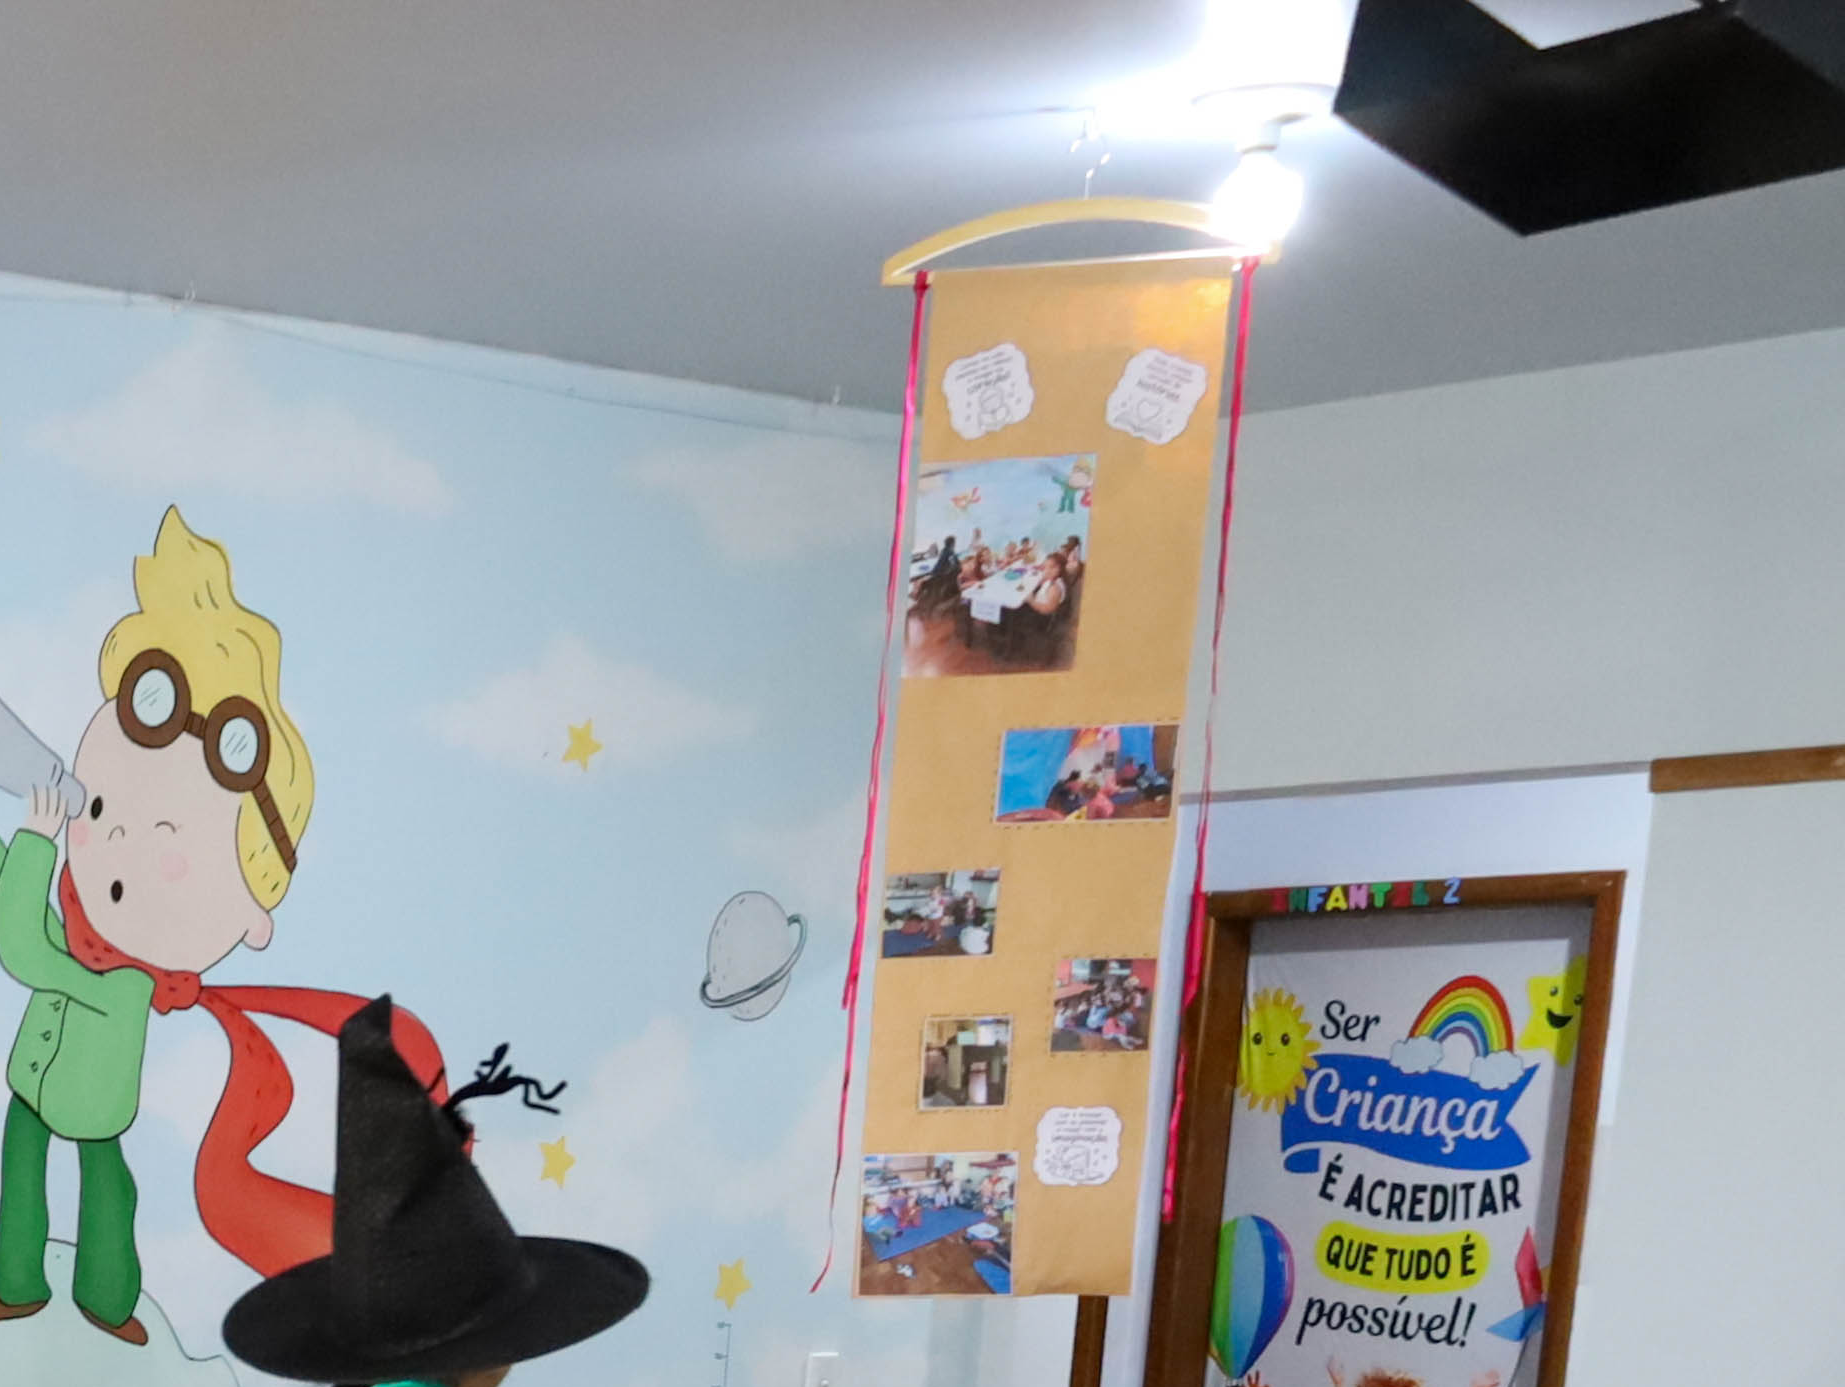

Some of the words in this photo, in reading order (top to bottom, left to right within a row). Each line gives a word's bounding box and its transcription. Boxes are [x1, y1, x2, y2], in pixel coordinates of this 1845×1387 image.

[1270, 880, 1430, 913] INFANTIL
[1442, 876, 1462, 905] 2
[1320, 1000, 1380, 1042] Ser
[1304, 1067, 1501, 1154] Criança
[1318, 1153, 1343, 1201] É
[1343, 1173, 1522, 1223] ACREDITAR
[1326, 1235, 1378, 1276] QUE
[1385, 1247, 1451, 1280] TUDO
[1460, 1233, 1476, 1277] É
[1295, 1295, 1477, 1347] possível!
